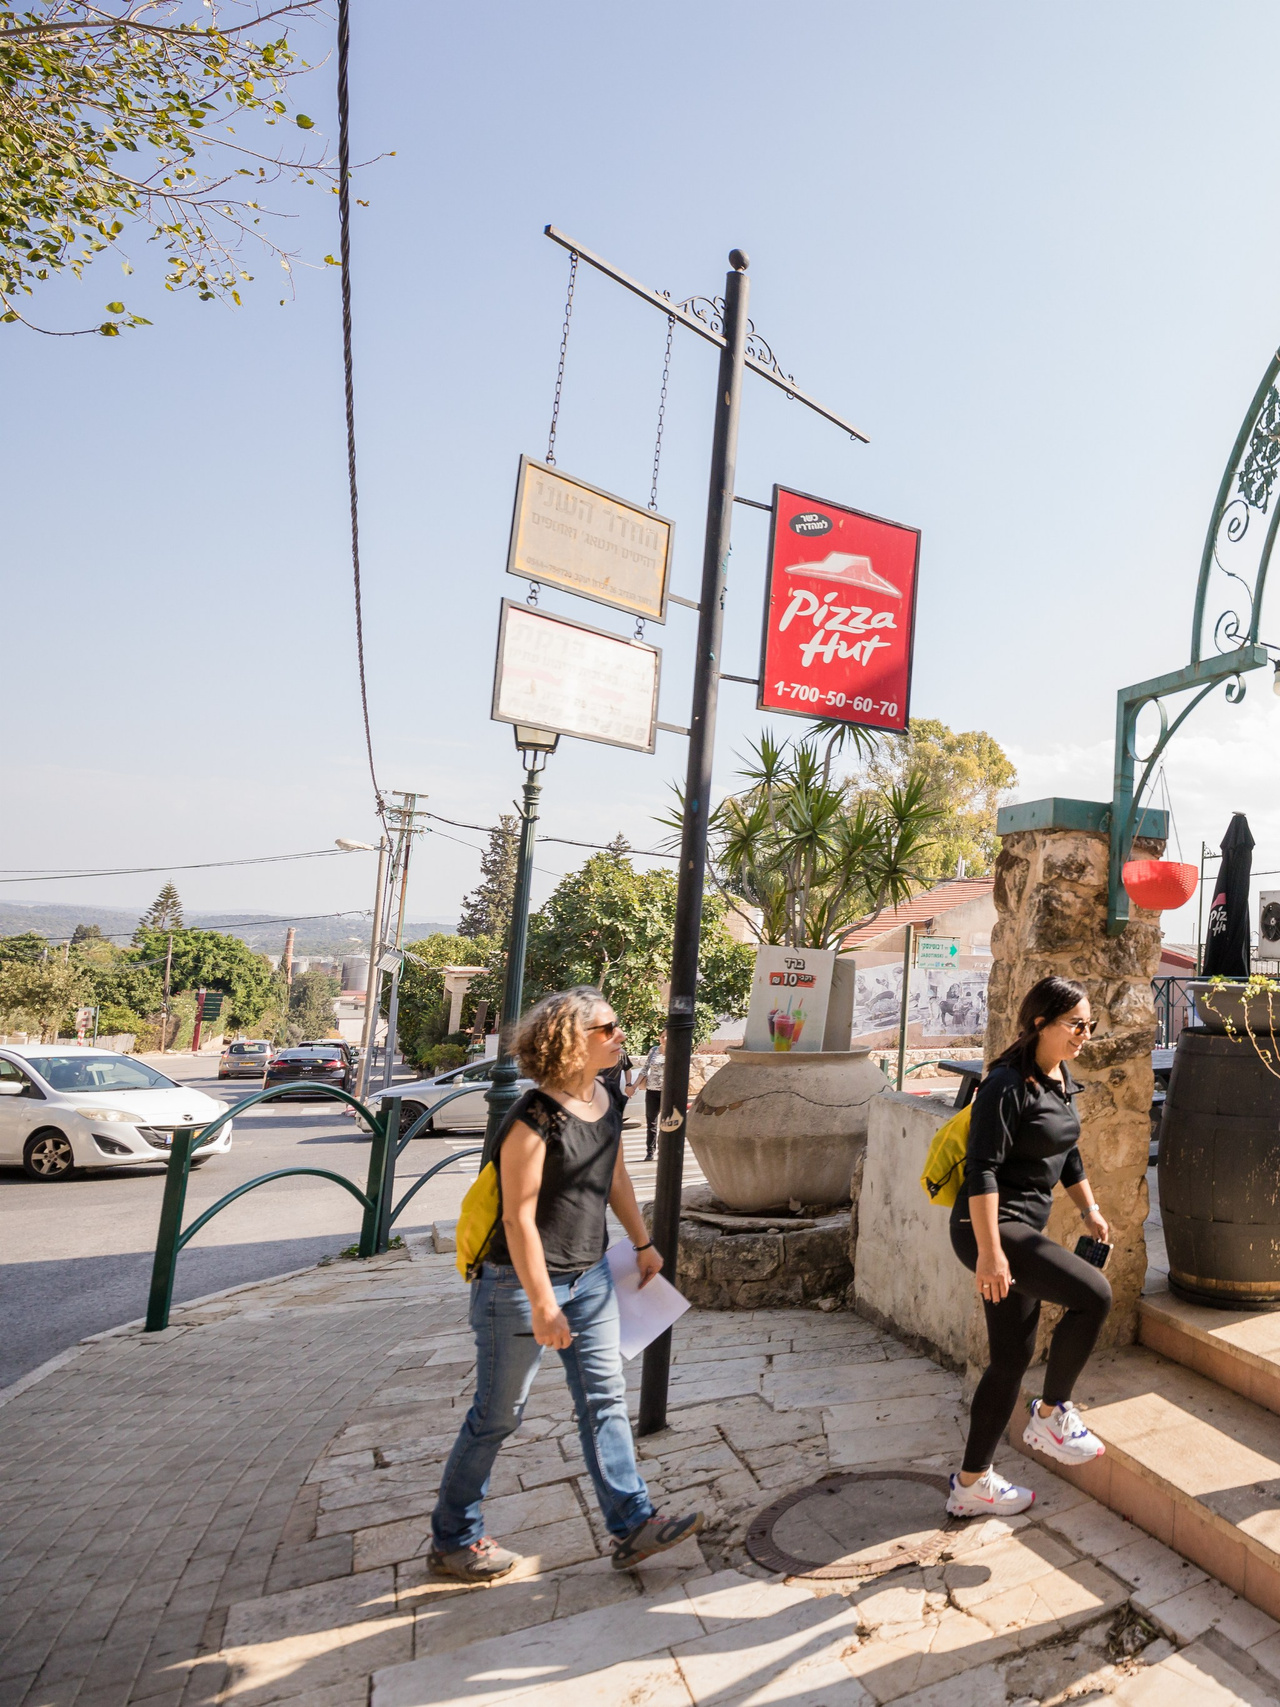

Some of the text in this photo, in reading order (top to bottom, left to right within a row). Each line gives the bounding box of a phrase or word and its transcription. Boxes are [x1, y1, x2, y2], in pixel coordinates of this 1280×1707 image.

[536, 480, 659, 550] החדר השני
[795, 520, 829, 531] למהדרין
[800, 513, 819, 523] כשר
[778, 589, 898, 634] Pizza
[799, 628, 892, 668] Hut
[774, 680, 899, 718] 1-700-50-60-70
[785, 957, 806, 970] ברד
[783, 972, 798, 987] 10
